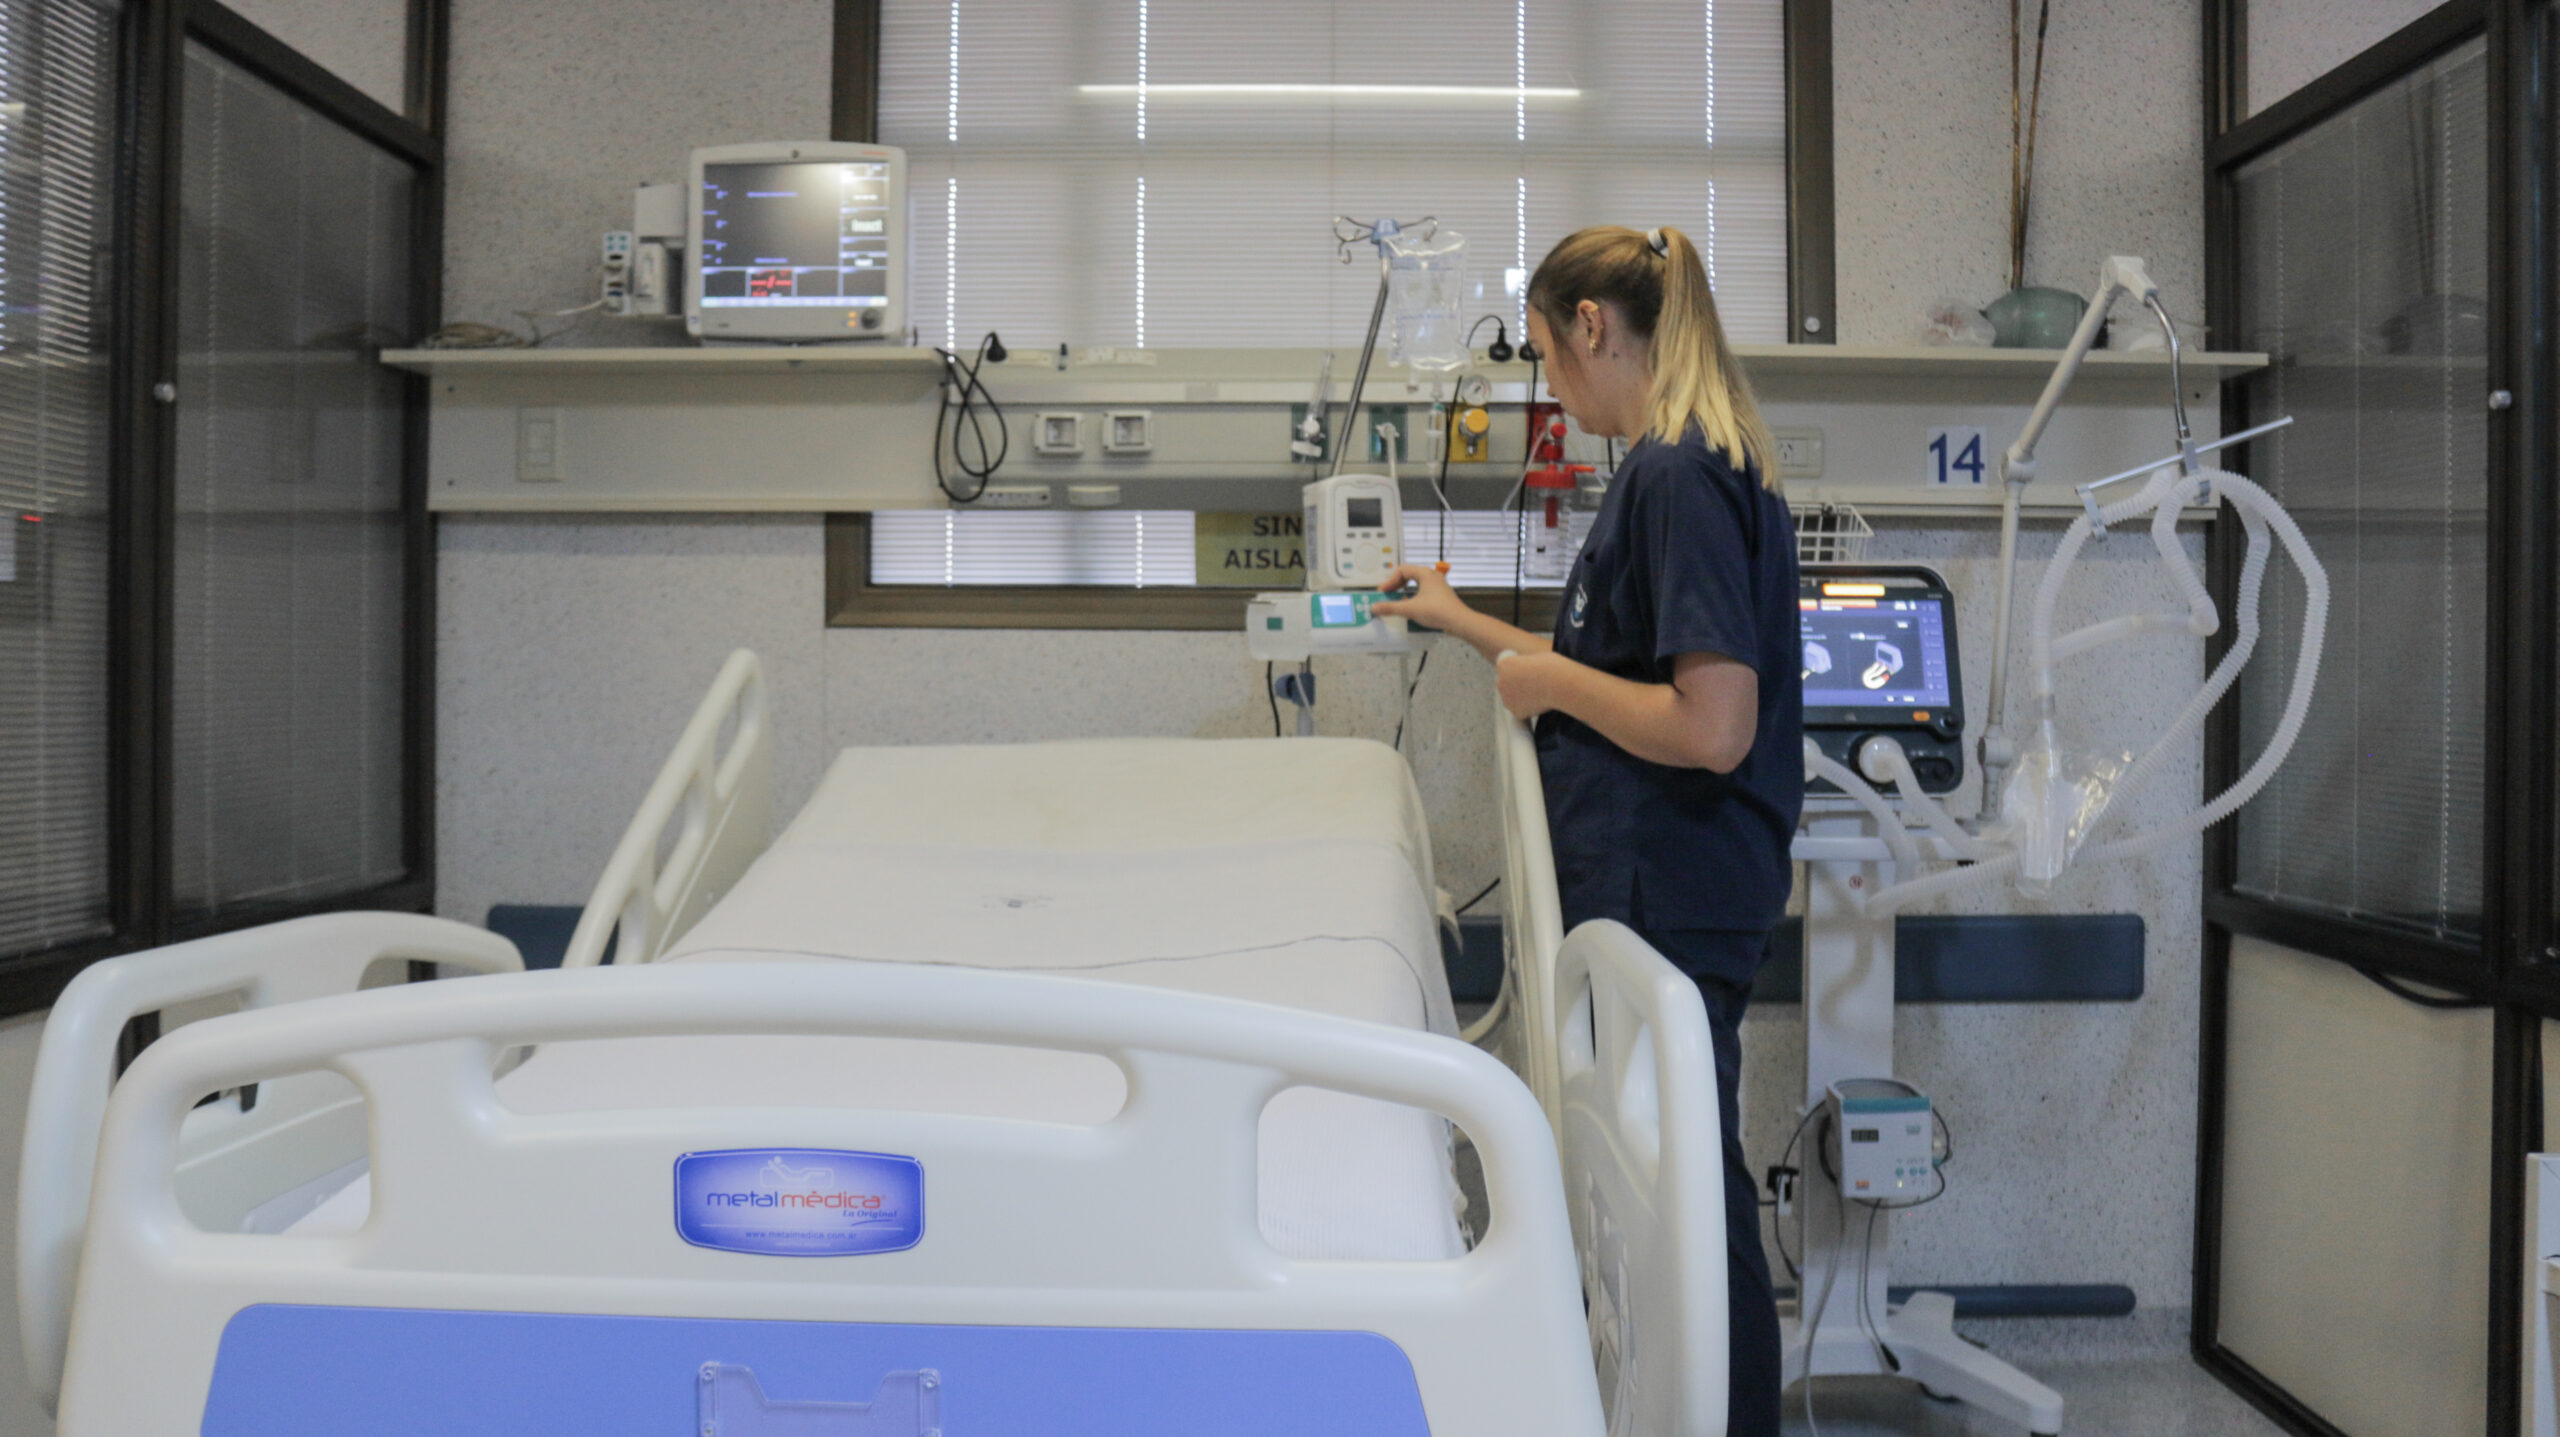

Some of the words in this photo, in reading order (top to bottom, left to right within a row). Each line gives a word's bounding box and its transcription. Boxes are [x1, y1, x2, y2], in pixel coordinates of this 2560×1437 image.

[1929, 432, 1985, 483] 14
[1253, 515, 1303, 536] SIN
[856, 1210, 897, 1218] Original
